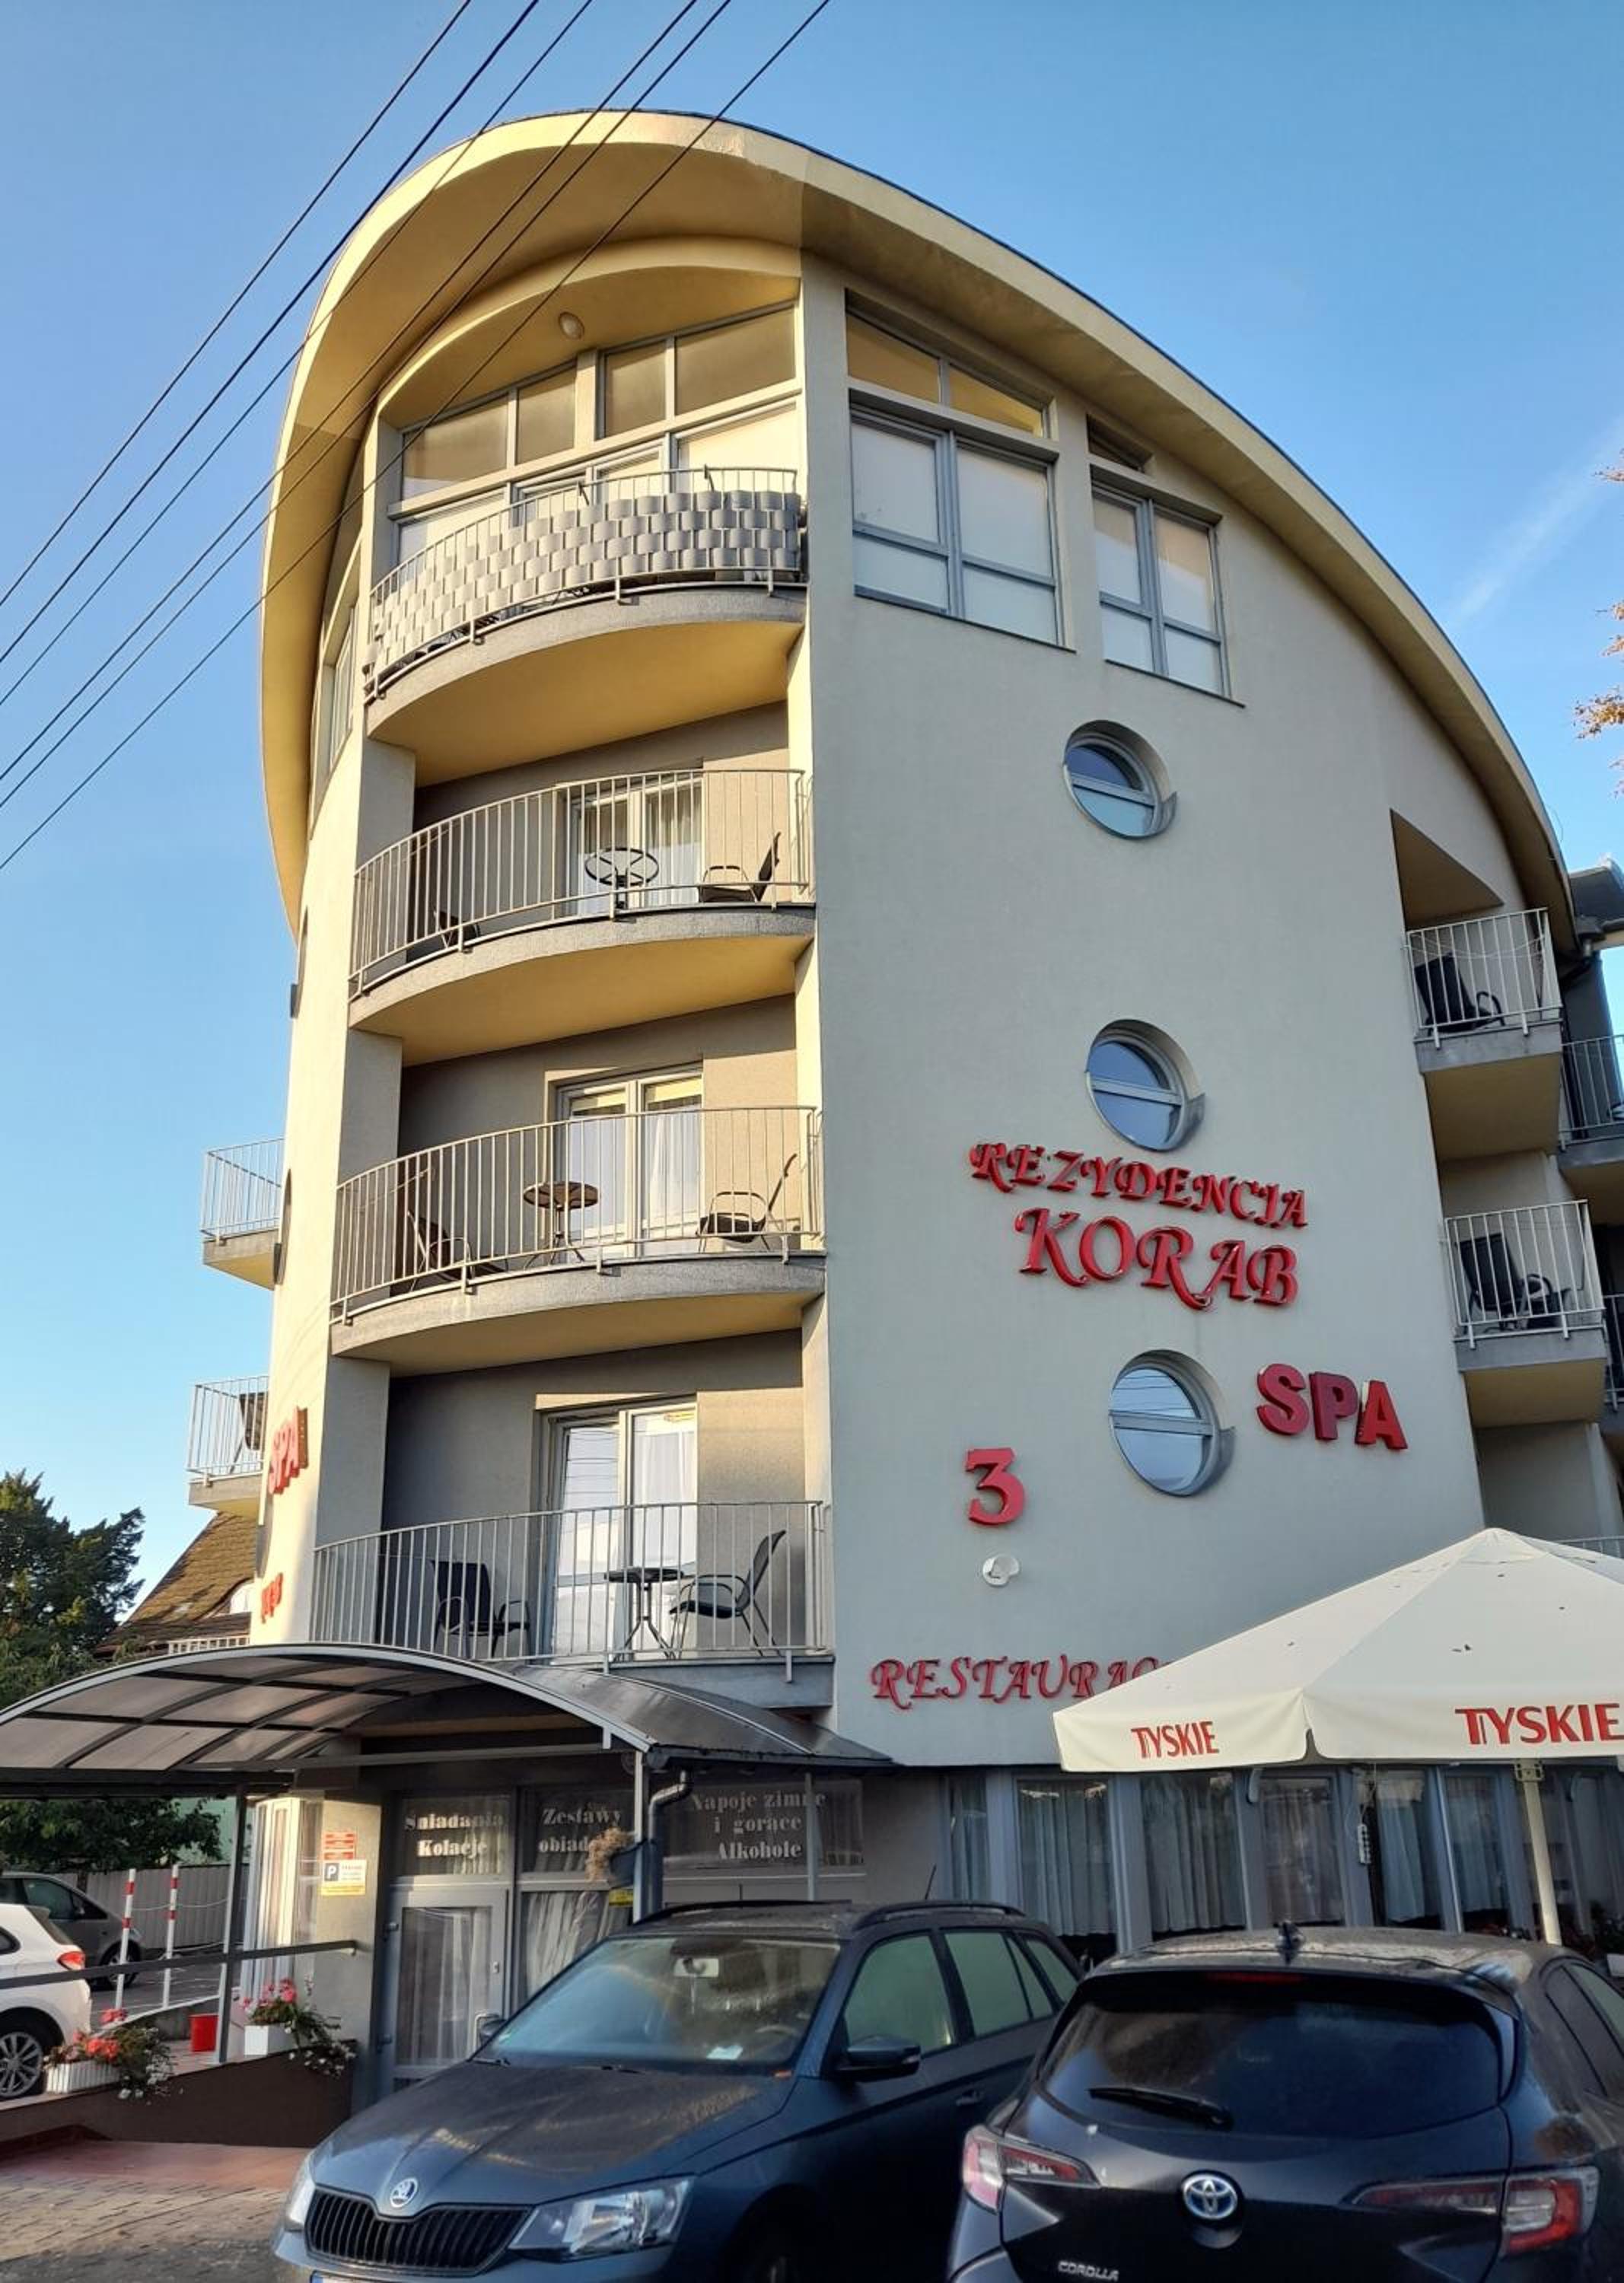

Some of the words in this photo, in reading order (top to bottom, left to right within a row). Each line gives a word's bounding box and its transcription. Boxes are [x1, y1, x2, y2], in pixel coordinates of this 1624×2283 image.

[1013, 1207, 1298, 1311] KORAB
[1256, 1363, 1408, 1450] SPA
[965, 1447, 1024, 1525] 3
[871, 1654, 1172, 1710] RESTAURA
[1130, 1721, 1220, 1758] TYSKIE
[1454, 1702, 1624, 1745] TYSKIE
[714, 1816, 721, 1834] i
[416, 1839, 488, 1859] Kolacje
[718, 1840, 801, 1861] Alkohole
[1058, 2260, 1119, 2282] COROLLA
